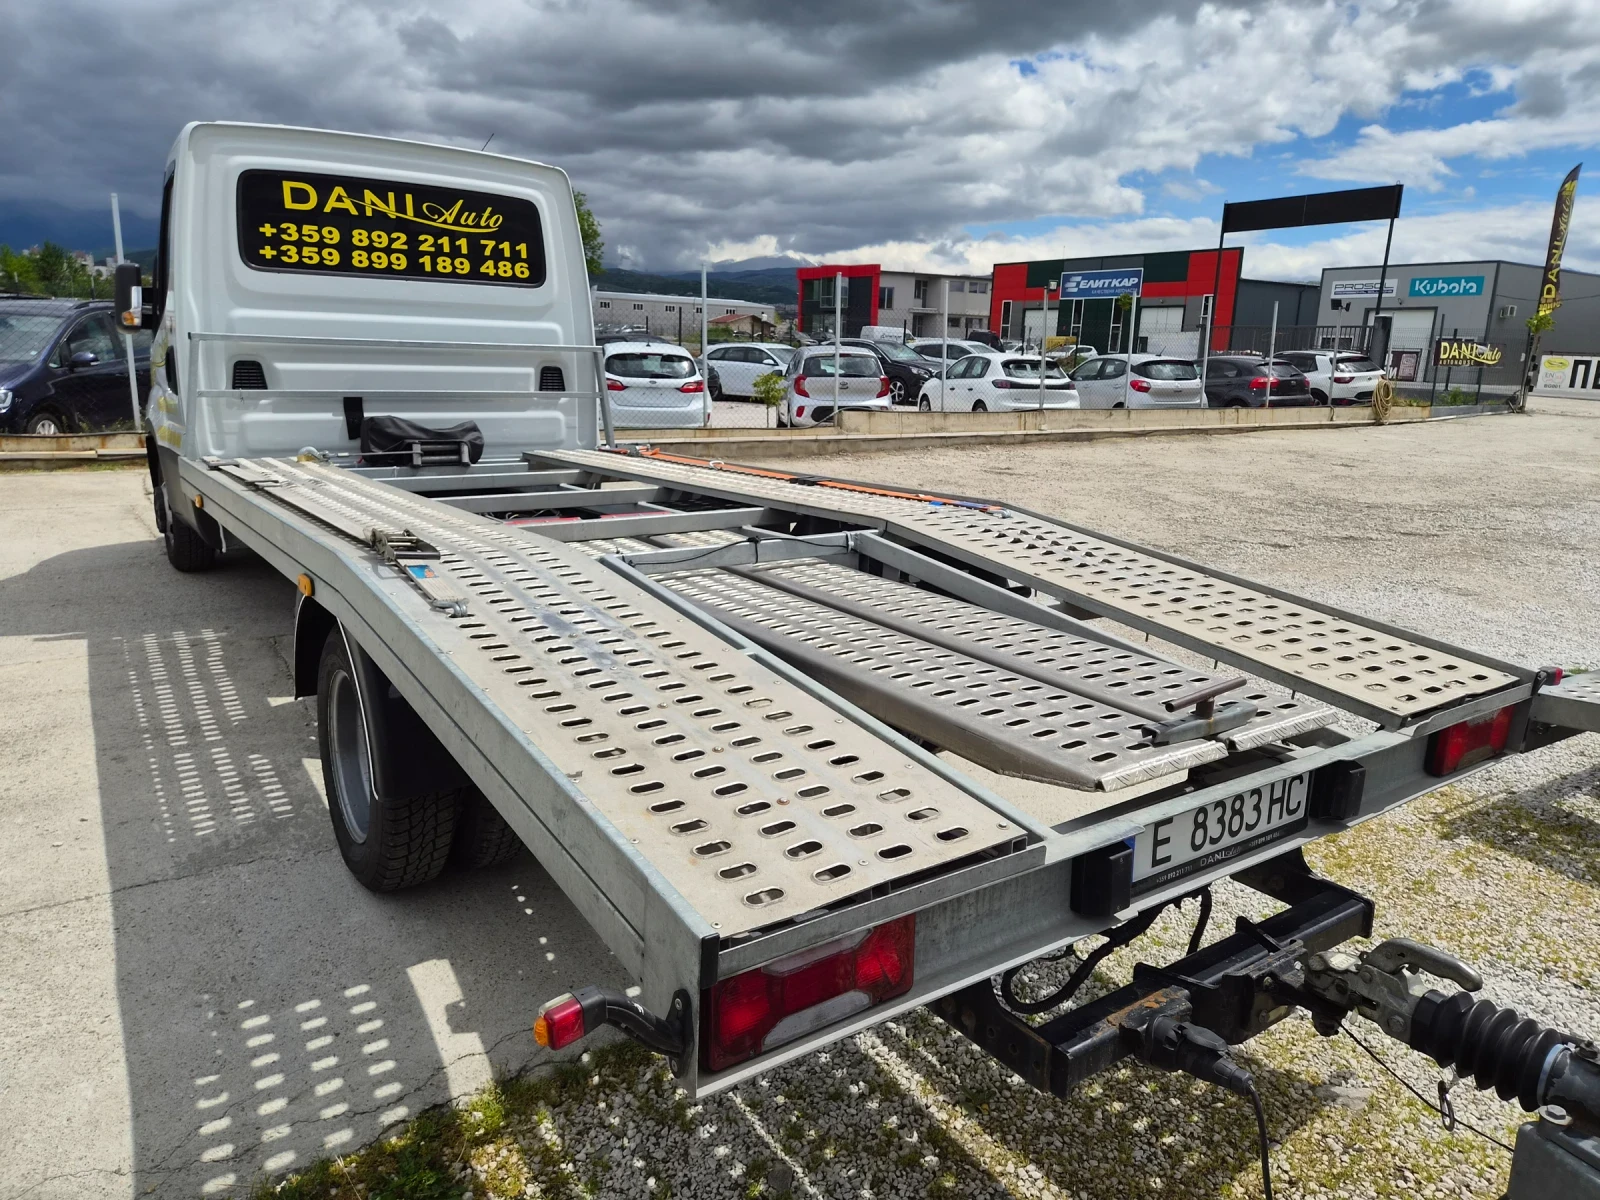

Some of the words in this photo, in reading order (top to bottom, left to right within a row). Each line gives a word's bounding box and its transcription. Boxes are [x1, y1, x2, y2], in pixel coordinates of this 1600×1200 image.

[282, 180, 415, 219] DANI
[422, 199, 503, 228] Auto
[259, 223, 341, 245] +359
[352, 229, 408, 250] 892
[418, 234, 468, 254] 211
[480, 239, 528, 259] 711
[259, 245, 341, 266] +359
[352, 251, 408, 270] 899
[419, 255, 470, 275] 189
[480, 261, 530, 279] 486
[1544, 241, 1562, 298] DANI
[1079, 277, 1139, 289] ЕЛИТКАР
[1335, 282, 1394, 290] PROSOL
[1415, 279, 1477, 294] Kubota
[1440, 341, 1477, 360] DANI
[1151, 818, 1173, 868] E
[1190, 788, 1262, 852] 8383
[1267, 775, 1304, 825] HC
[1200, 850, 1225, 867] DANI
